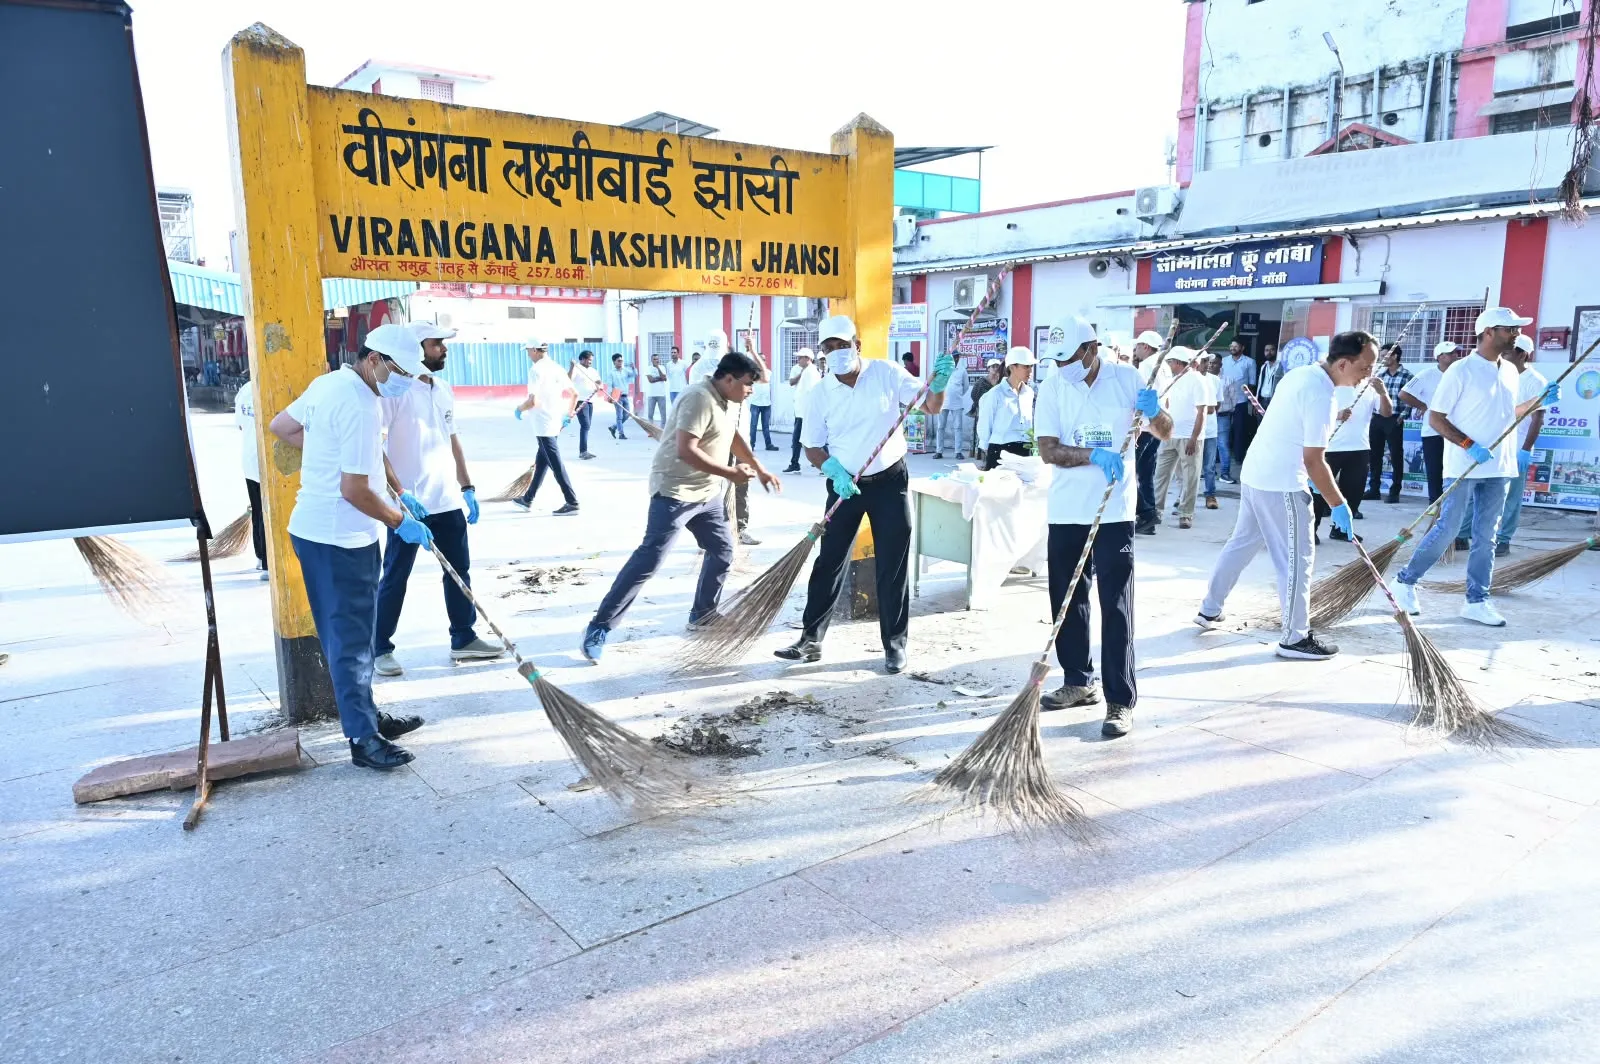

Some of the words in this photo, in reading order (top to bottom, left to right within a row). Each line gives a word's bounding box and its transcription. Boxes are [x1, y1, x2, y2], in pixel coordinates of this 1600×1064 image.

[342, 107, 491, 194] वीरांगना
[502, 130, 676, 218] लक्ष्मीबाई
[329, 214, 556, 265] VIRANGANA
[570, 228, 742, 272] LAKSHMIBAI
[752, 241, 839, 277] JHANSI
[739, 276, 780, 289] 257.86
[1549, 406, 1561, 414] &
[1547, 417, 1588, 428] 2026
